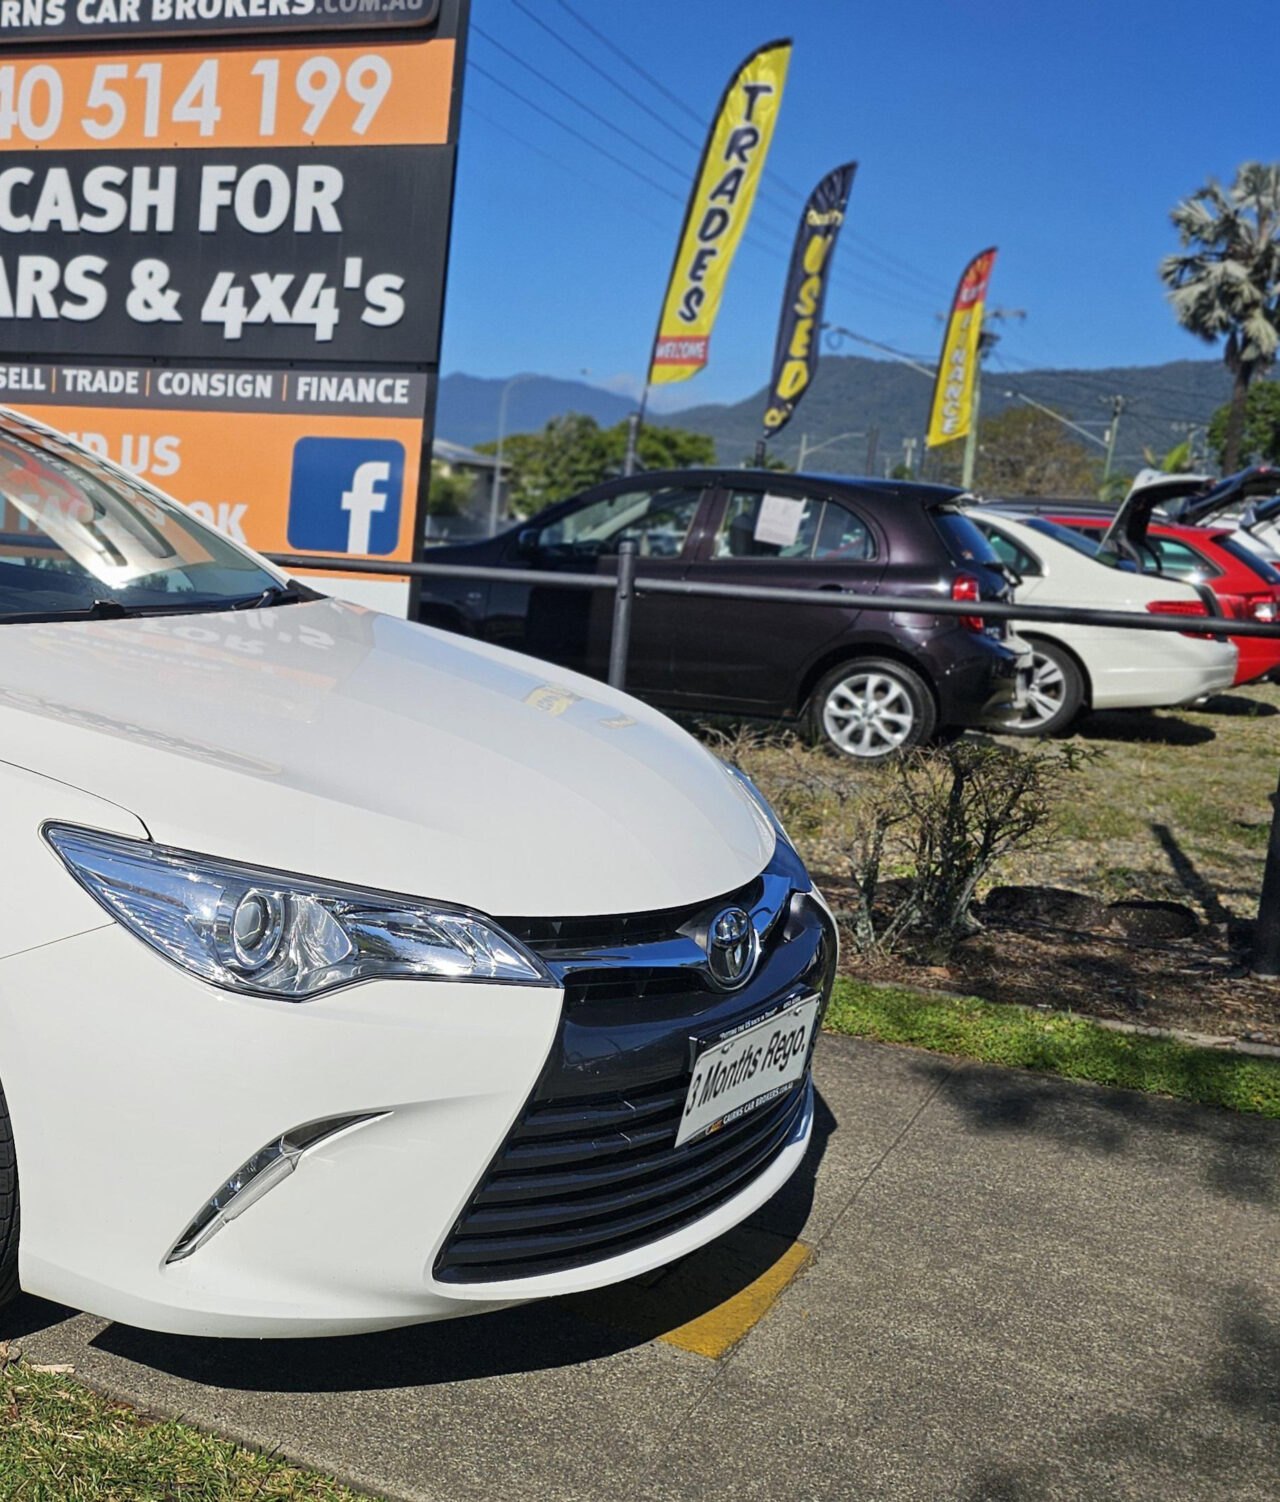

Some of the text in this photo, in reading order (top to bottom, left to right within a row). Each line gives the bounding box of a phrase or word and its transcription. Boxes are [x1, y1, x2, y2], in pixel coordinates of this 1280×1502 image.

[76, 0, 140, 24] CAR
[80, 59, 221, 139] 514
[250, 54, 392, 136] 199
[199, 164, 344, 234] FOR
[679, 84, 773, 323] TRADES
[126, 259, 182, 323] &
[778, 234, 832, 399] USED
[655, 341, 705, 359] WELCOME
[63, 369, 139, 395] TRADE
[158, 371, 272, 399] CONSIGN
[297, 376, 410, 404] FINANCE
[121, 434, 181, 476] US
[685, 1026, 805, 1117] 3 Months Rego.
